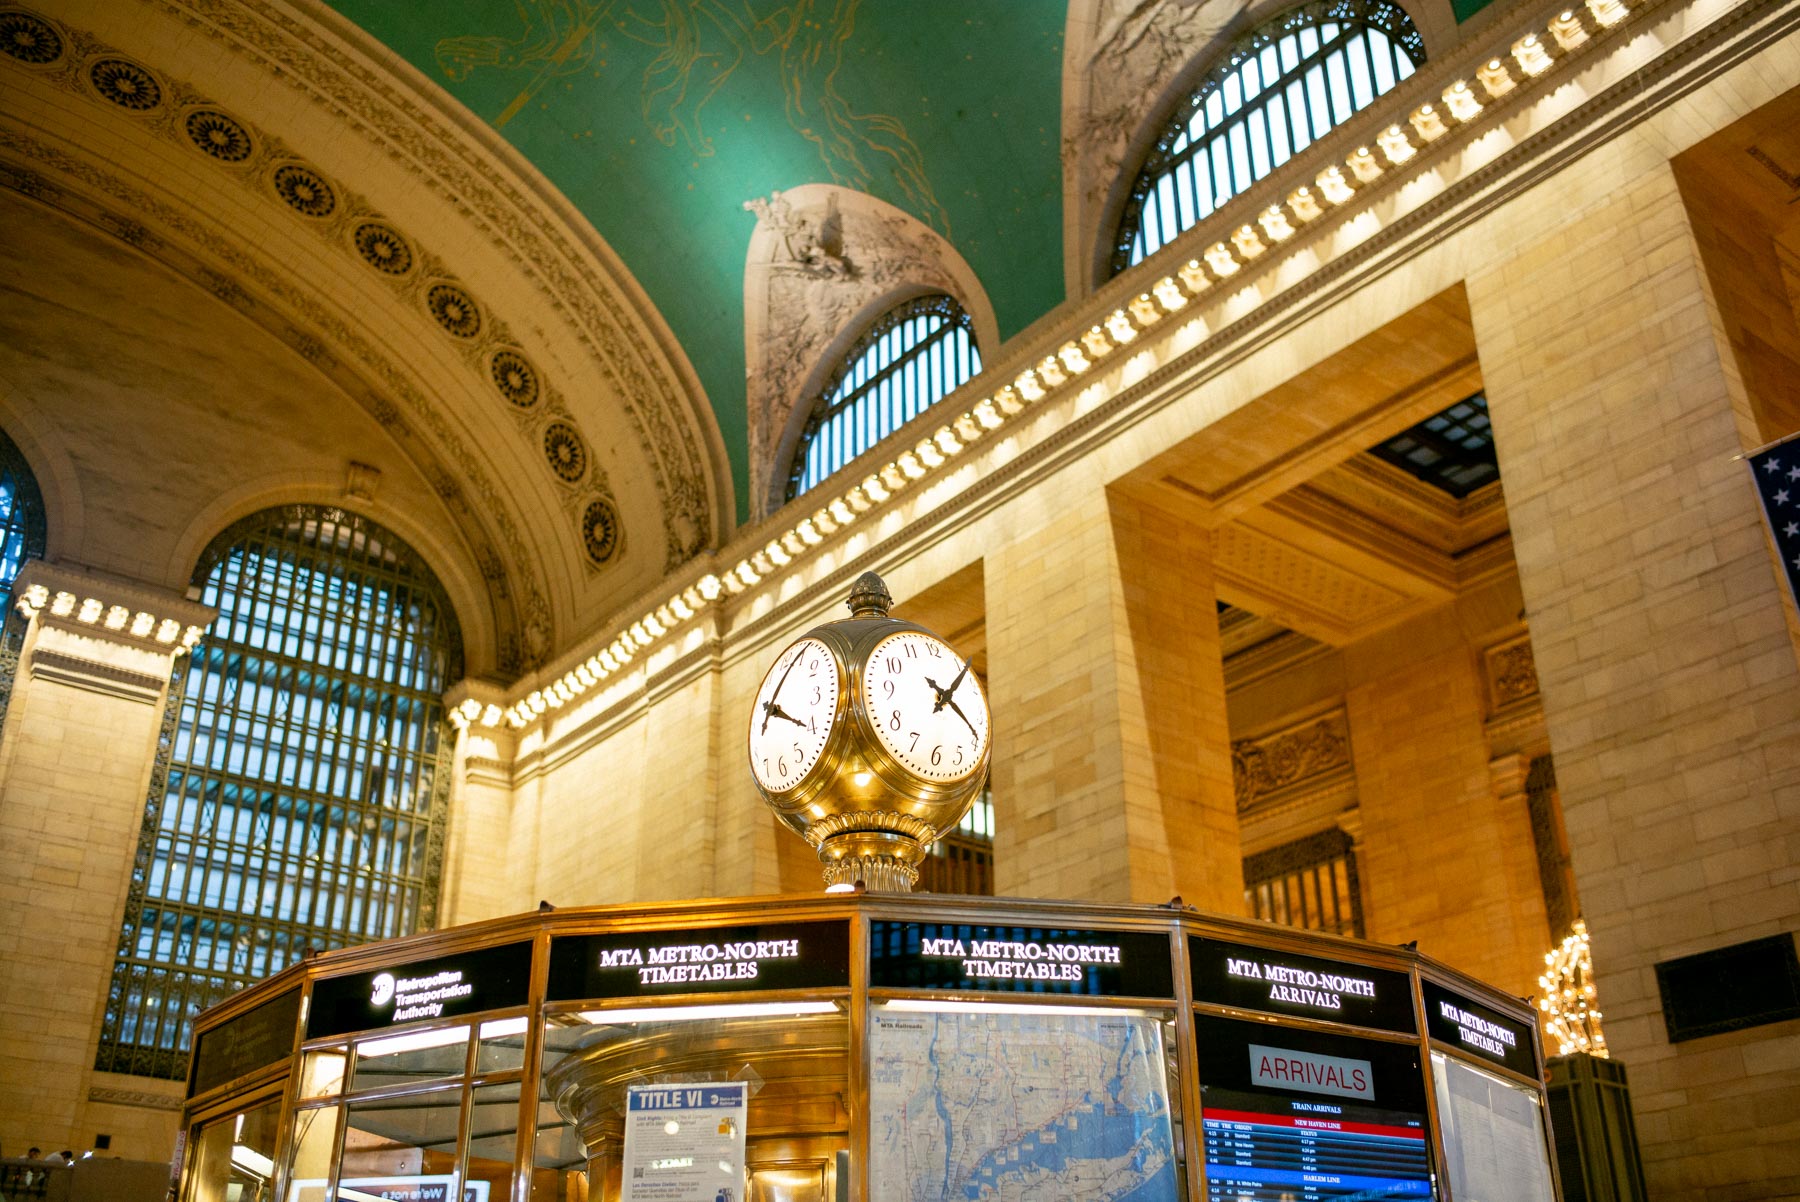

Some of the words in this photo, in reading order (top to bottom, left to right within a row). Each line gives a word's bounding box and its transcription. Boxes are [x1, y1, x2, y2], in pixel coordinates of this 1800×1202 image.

[904, 643, 918, 659] 11
[925, 642, 942, 658] 12
[809, 659, 819, 678] 2
[886, 657, 902, 674] 10
[810, 685, 821, 706] 3
[883, 680, 895, 700] 9
[806, 715, 818, 735] 4
[889, 710, 901, 731] 8
[793, 742, 804, 763] 5
[909, 732, 921, 752] 7
[778, 755, 788, 777] 6
[930, 745, 943, 766] 6
[952, 745, 963, 766] 5
[600, 948, 643, 967] MTA
[648, 939, 799, 965] METRO-NORTH
[922, 938, 966, 957] MTA
[971, 940, 1120, 964] METRO-NORTH
[638, 961, 758, 985] TIMETABLES
[963, 959, 1083, 981] TIMETABLES
[1227, 958, 1262, 979] MTA
[1264, 964, 1375, 997] METRO-NORTH
[396, 971, 462, 992] Metropolitan
[395, 984, 472, 1006] Transportation
[1269, 984, 1341, 1009] ARRIVALS
[393, 1003, 443, 1021] Authority
[1440, 1001, 1459, 1022] MTA
[1459, 1009, 1516, 1046] METRO-NORTH
[1458, 1025, 1504, 1057] TIMETABLES
[1259, 1055, 1366, 1091] ARRIVALS
[639, 1091, 682, 1109] TITLE
[686, 1090, 702, 1107] VI
[1292, 1102, 1312, 1112] TRAIN
[1312, 1104, 1342, 1114] ARRIVALS
[1295, 1119, 1307, 1127] NEW
[1308, 1120, 1327, 1128] HAVEN
[1303, 1174, 1326, 1183] HARLEM
